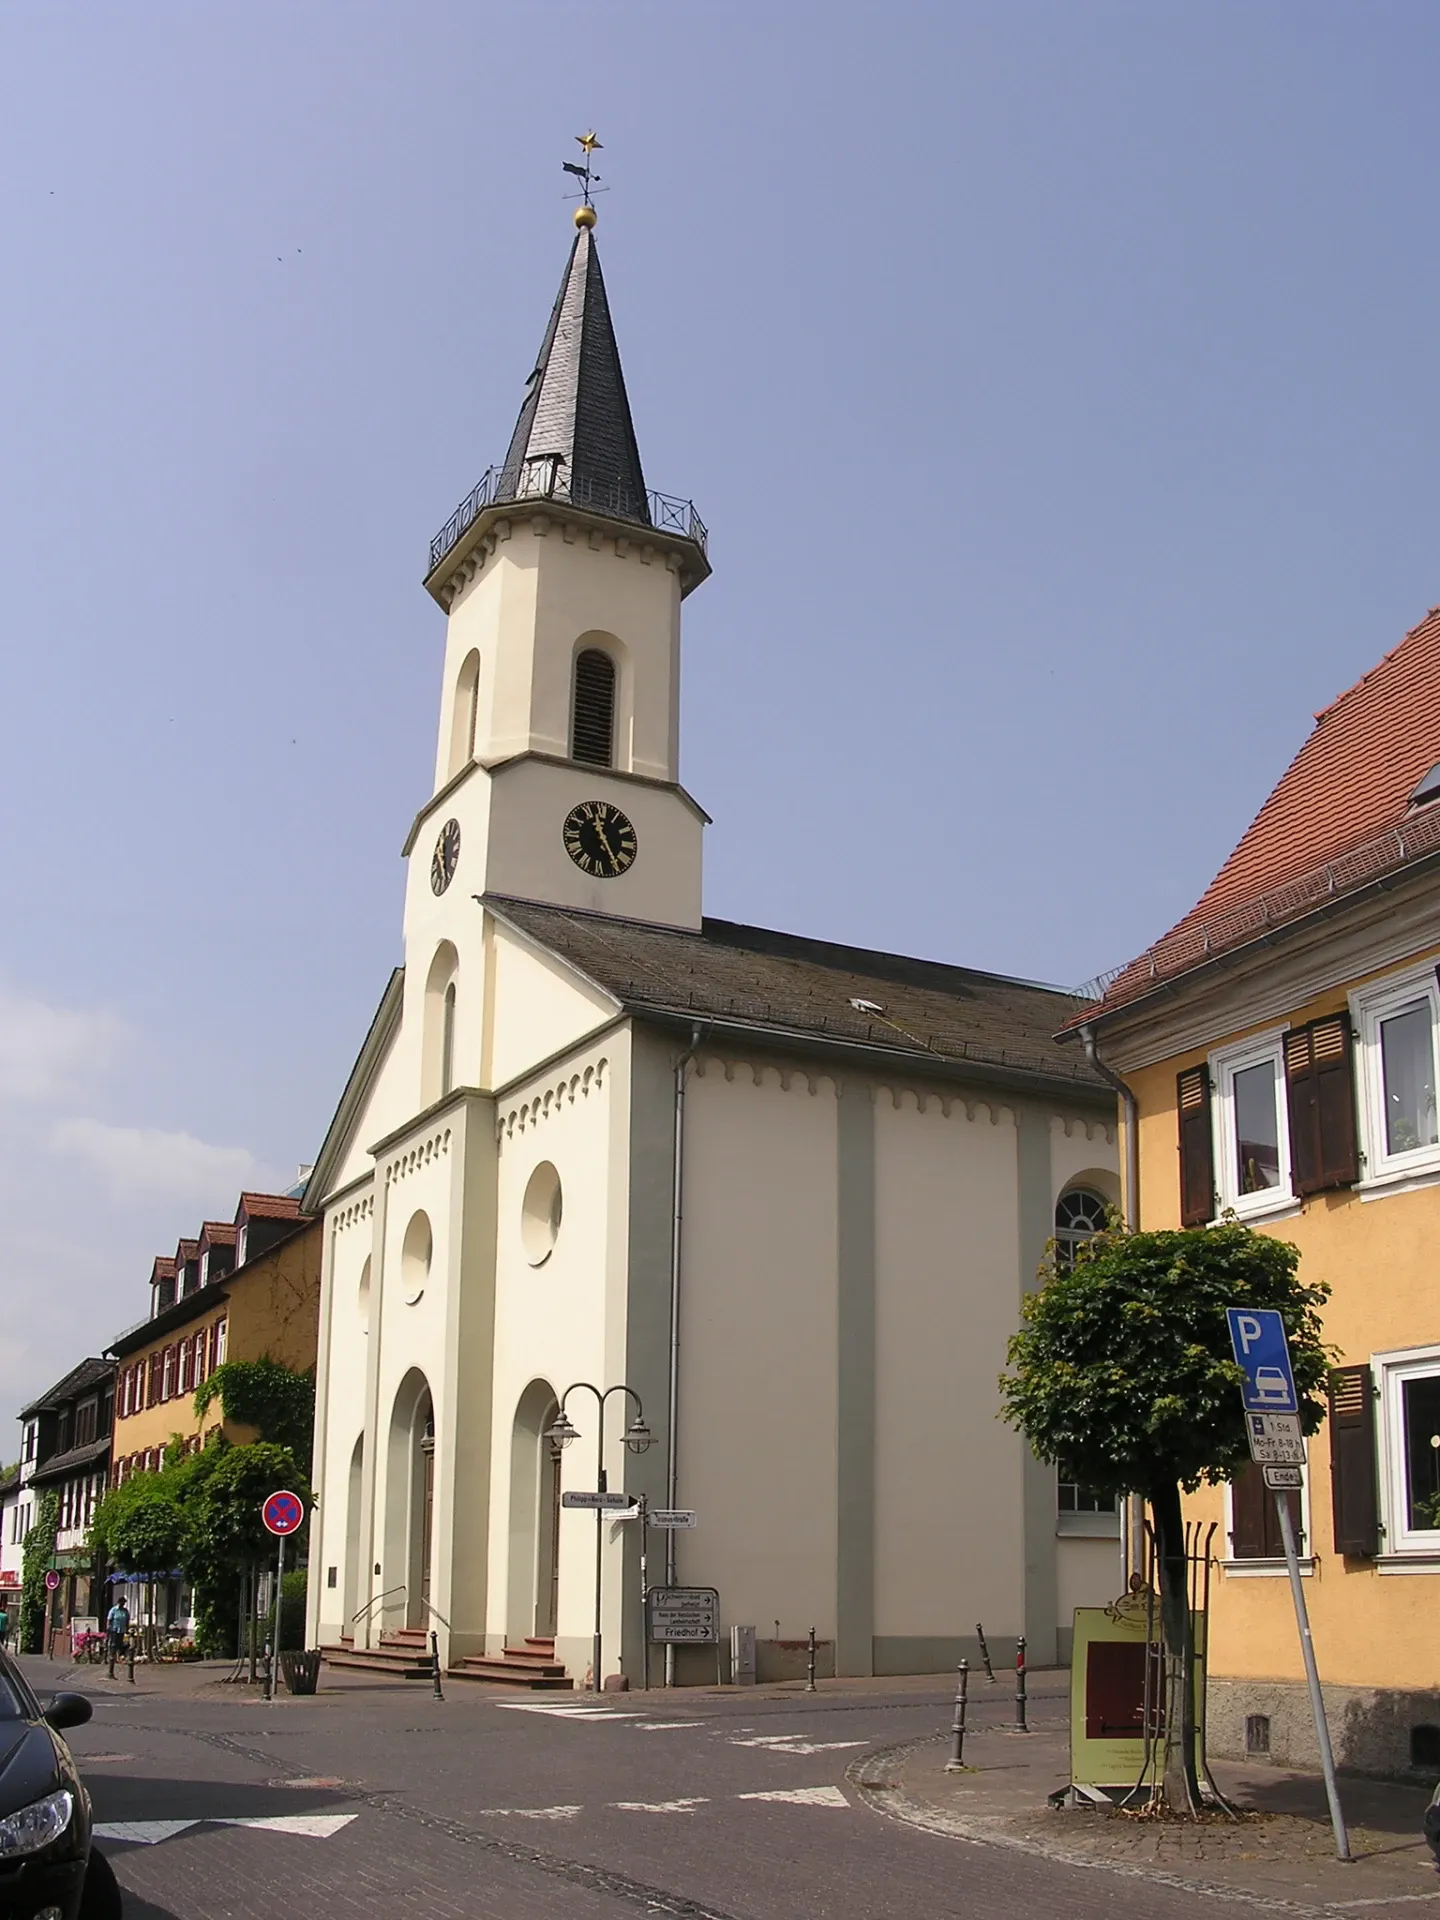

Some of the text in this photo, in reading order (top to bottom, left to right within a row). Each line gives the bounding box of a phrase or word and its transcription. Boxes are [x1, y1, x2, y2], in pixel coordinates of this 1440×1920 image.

[1237, 1316, 1262, 1354] P
[1270, 1422, 1292, 1432] 1 Std.
[1253, 1438, 1300, 1448] Mo-Fr 8-18 h
[1260, 1449, 1270, 1459] Sa
[1272, 1450, 1290, 1460] 8-13
[1274, 1471, 1294, 1481] Ende
[665, 1628, 698, 1636] Friedhof
